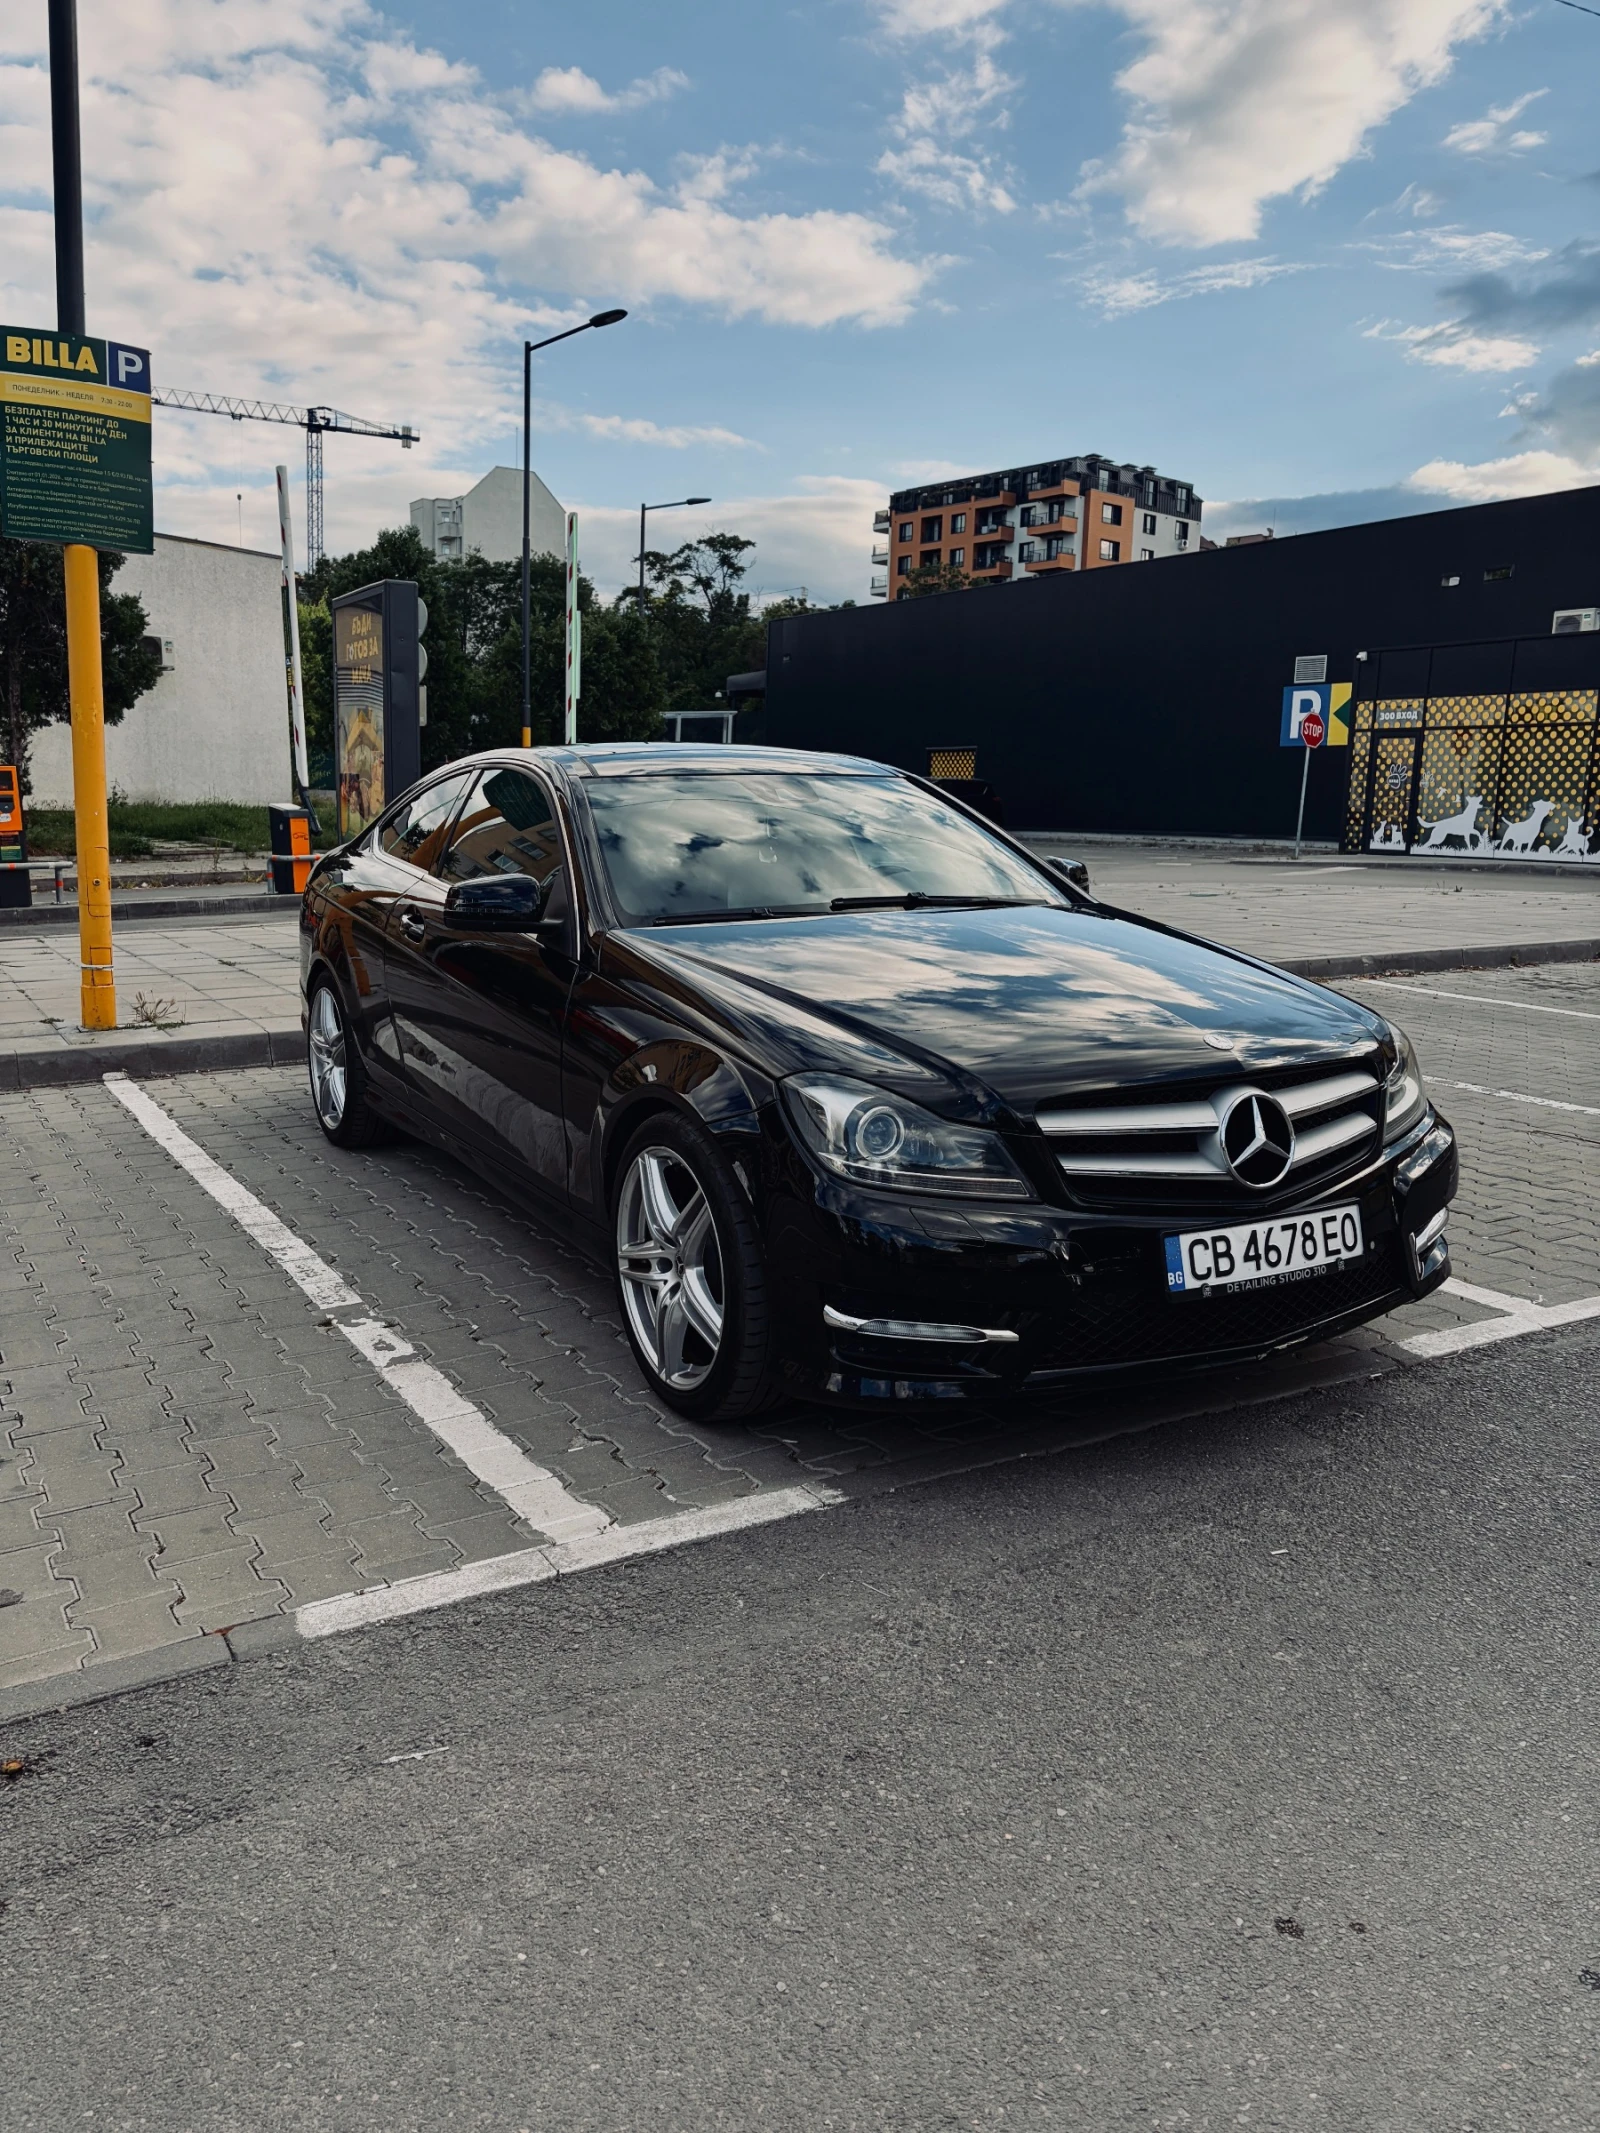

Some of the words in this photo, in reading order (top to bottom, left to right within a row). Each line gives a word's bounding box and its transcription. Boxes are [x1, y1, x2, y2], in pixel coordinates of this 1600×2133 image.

[7, 336, 98, 374] BILLA
[118, 350, 142, 382] P
[13, 385, 59, 395] ПОНЕДЕЛНИК
[66, 392, 93, 400] НЕДЕЛЯ
[5, 406, 59, 418] БЕЗПЛАТЕН
[62, 412, 104, 425] ПАРКИНГ
[106, 420, 118, 429] ДО
[13, 417, 30, 425] ЧАС
[55, 421, 93, 433] МИНУТИ
[96, 427, 107, 435] НА
[109, 430, 127, 439] ДЕН
[15, 436, 88, 454] ПРИЛЕЖАЩИТЕ
[20, 427, 63, 438] КЛИЕНТИ
[66, 432, 78, 440] НА
[81, 434, 106, 445] BILLA
[6, 445, 60, 457] ТЪРГОВСКИ
[64, 451, 98, 463] ПЛОЩИ
[346, 639, 368, 661] ГОТОВ
[369, 636, 379, 657] ЗА
[1290, 690, 1322, 739] P
[1396, 711, 1418, 720] ВХОД
[1304, 722, 1322, 738] STOP
[1188, 1234, 1235, 1281] CB
[1243, 1220, 1318, 1271] 4678
[1168, 1272, 1183, 1286] BG
[1227, 1275, 1276, 1294] DETAILING
[1279, 1268, 1311, 1285] STUDIO
[1312, 1265, 1327, 1277] 310
